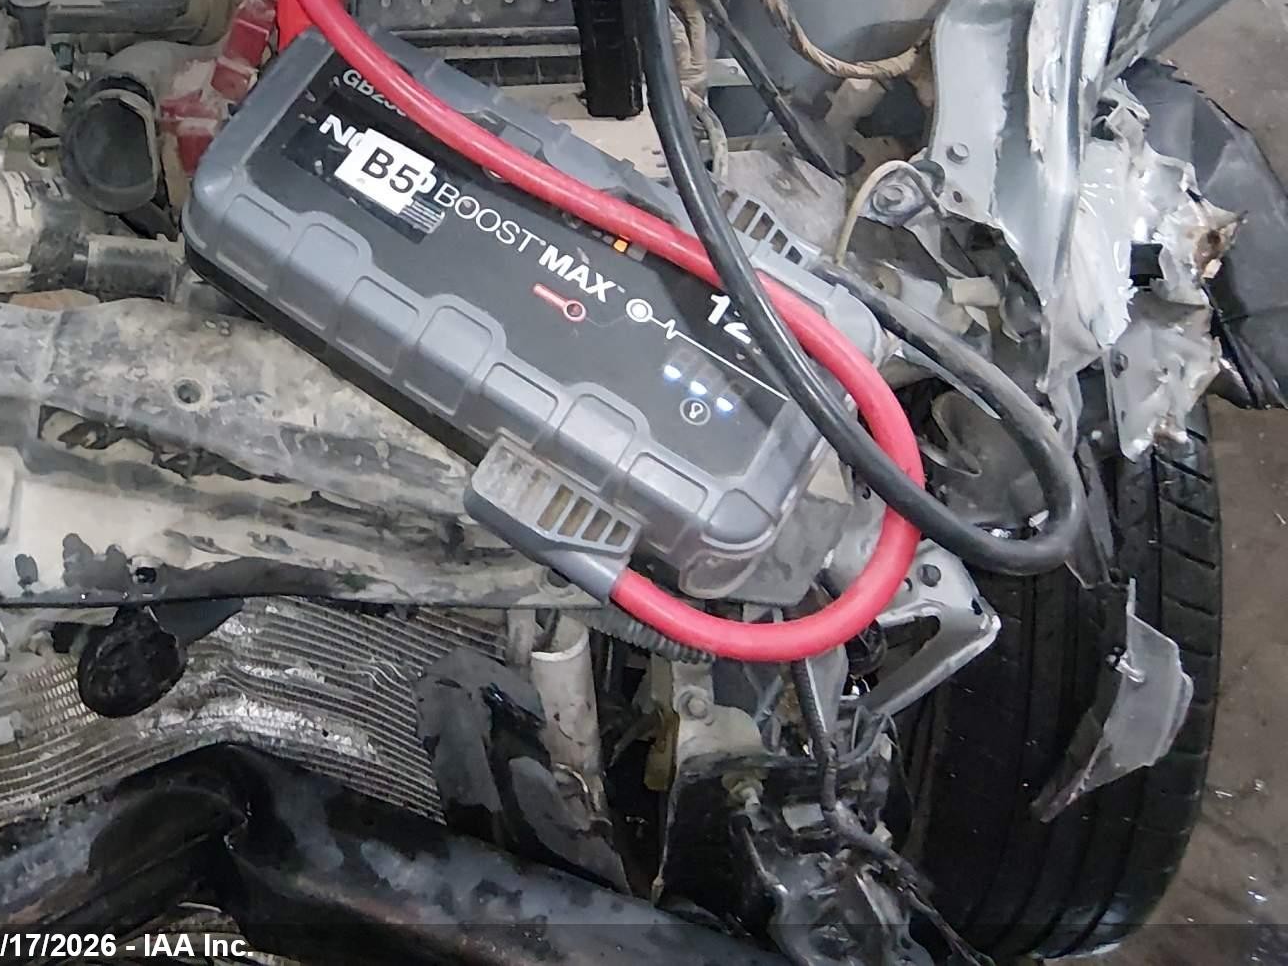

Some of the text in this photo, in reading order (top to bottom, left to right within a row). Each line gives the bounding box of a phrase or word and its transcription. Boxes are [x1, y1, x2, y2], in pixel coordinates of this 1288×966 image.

[361, 146, 421, 194] B5
[433, 182, 541, 253] BOOST
[538, 244, 616, 303] MAX
